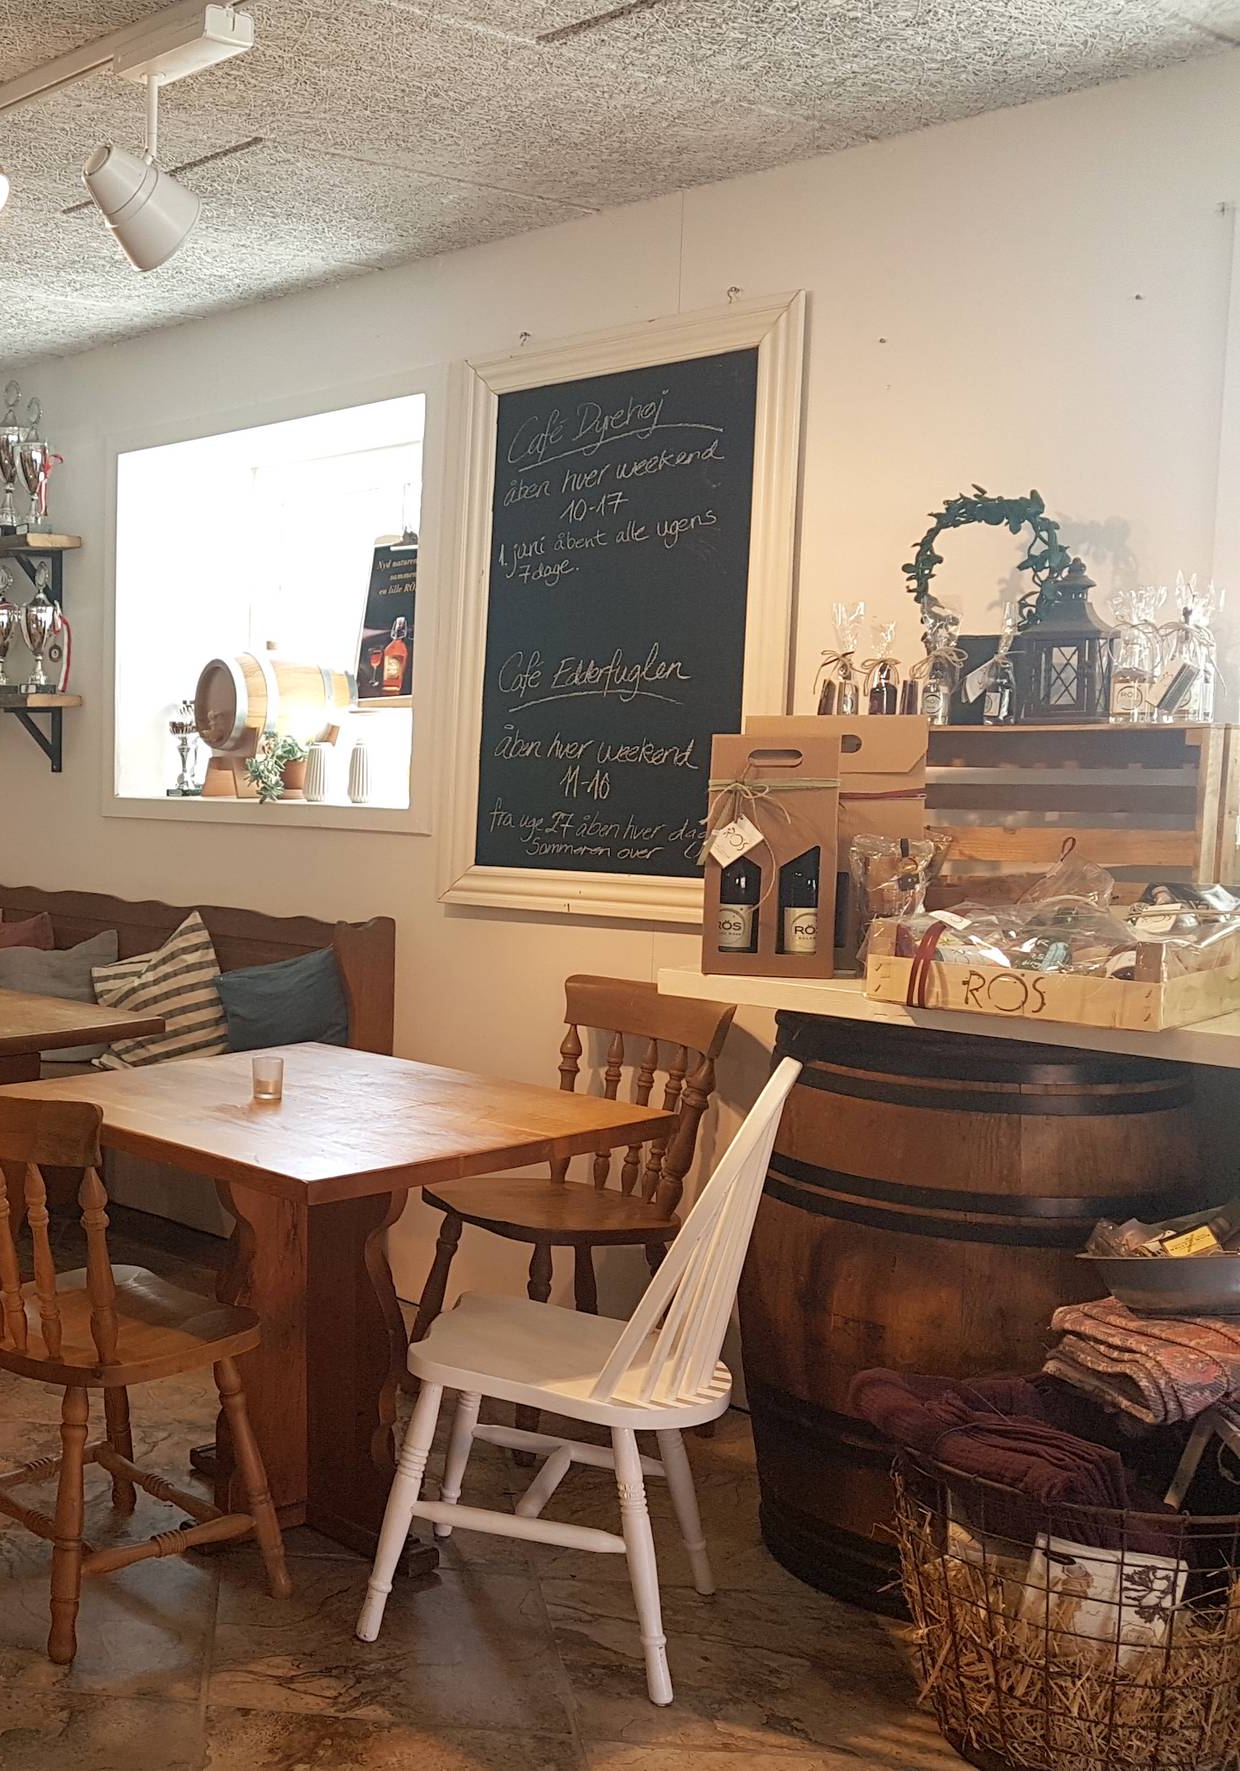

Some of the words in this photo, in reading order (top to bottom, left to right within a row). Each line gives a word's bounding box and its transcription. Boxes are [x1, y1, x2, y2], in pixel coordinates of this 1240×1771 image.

[507, 409, 563, 463] Café
[503, 479, 551, 506] åben
[561, 464, 607, 493] hver
[616, 439, 725, 480] weekend
[560, 492, 629, 522] 10-17
[554, 529, 609, 551] åbent
[615, 520, 649, 543] alle
[656, 510, 718, 549] ugens
[498, 650, 543, 697] Café
[494, 724, 542, 760] åben
[547, 732, 594, 760] hver
[597, 738, 699, 770] weekend
[489, 797, 515, 833] fra
[519, 815, 544, 842] uge
[575, 811, 620, 839] åben
[624, 814, 668, 840] hver
[617, 846, 665, 859] over
[794, 924, 817, 935] RÖ
